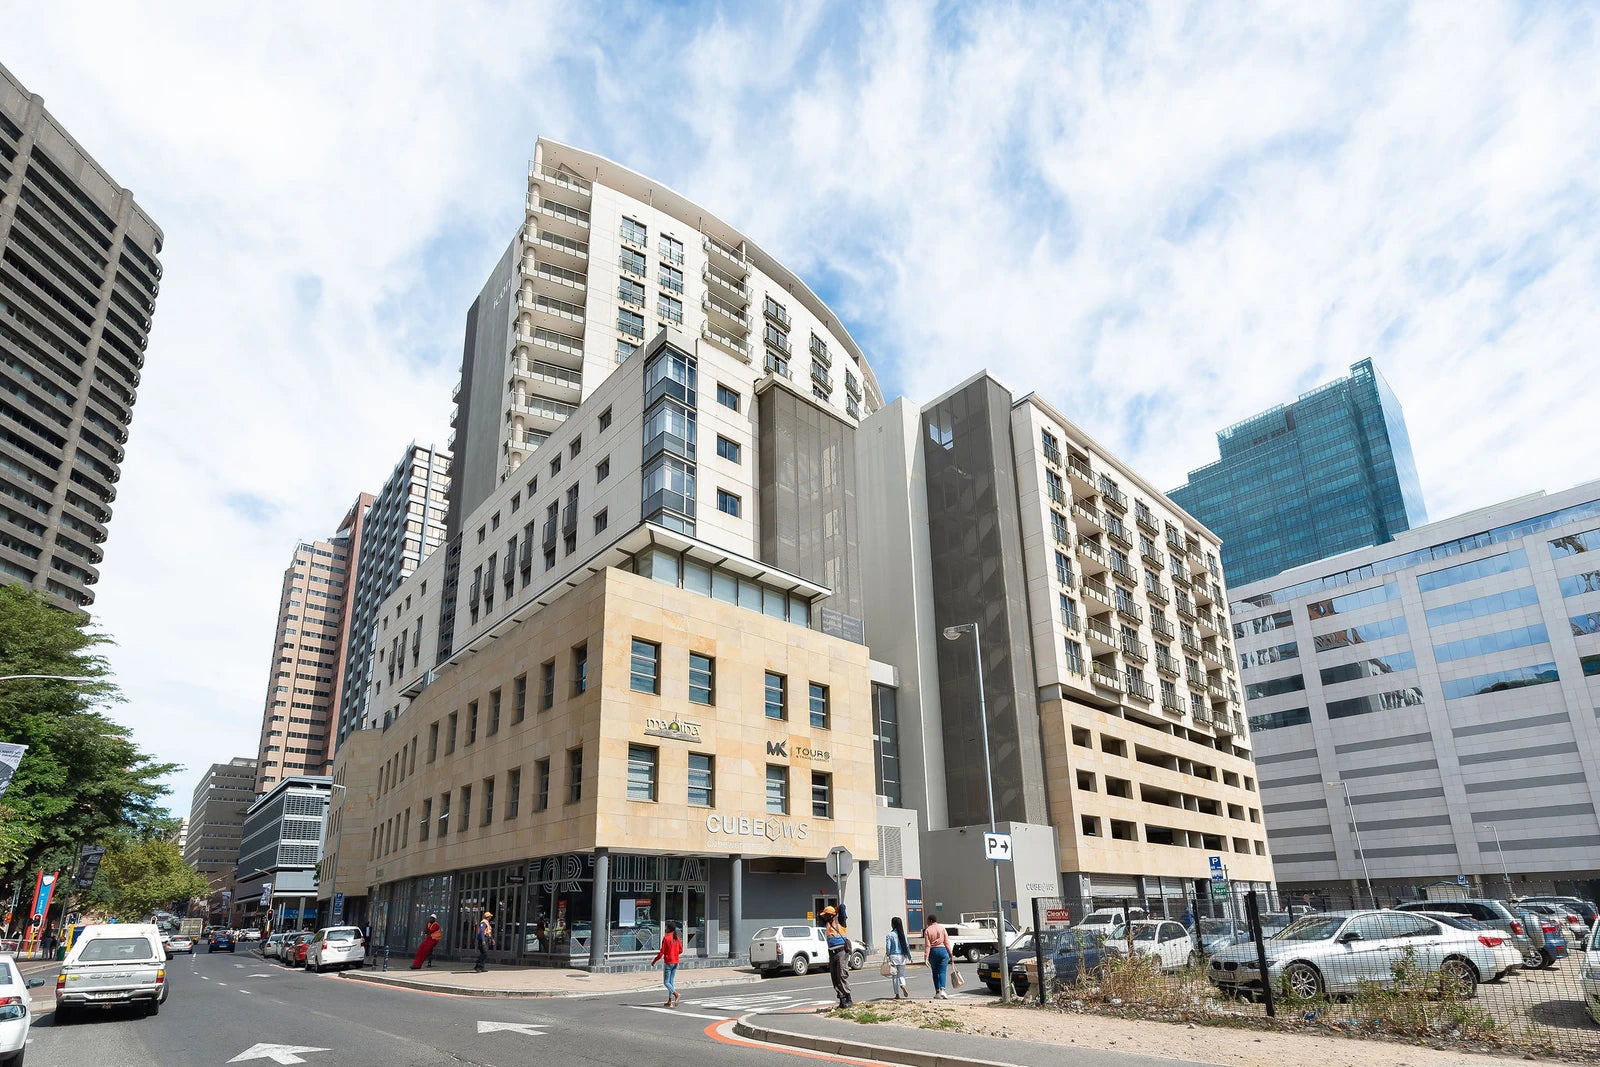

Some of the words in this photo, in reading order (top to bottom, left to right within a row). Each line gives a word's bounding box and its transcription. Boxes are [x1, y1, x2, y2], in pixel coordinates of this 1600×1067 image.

[766, 738, 788, 758] MK
[795, 746, 831, 760] TOURS
[988, 837, 998, 854] P
[1211, 857, 1218, 865] P
[89, 971, 136, 980] COLT
